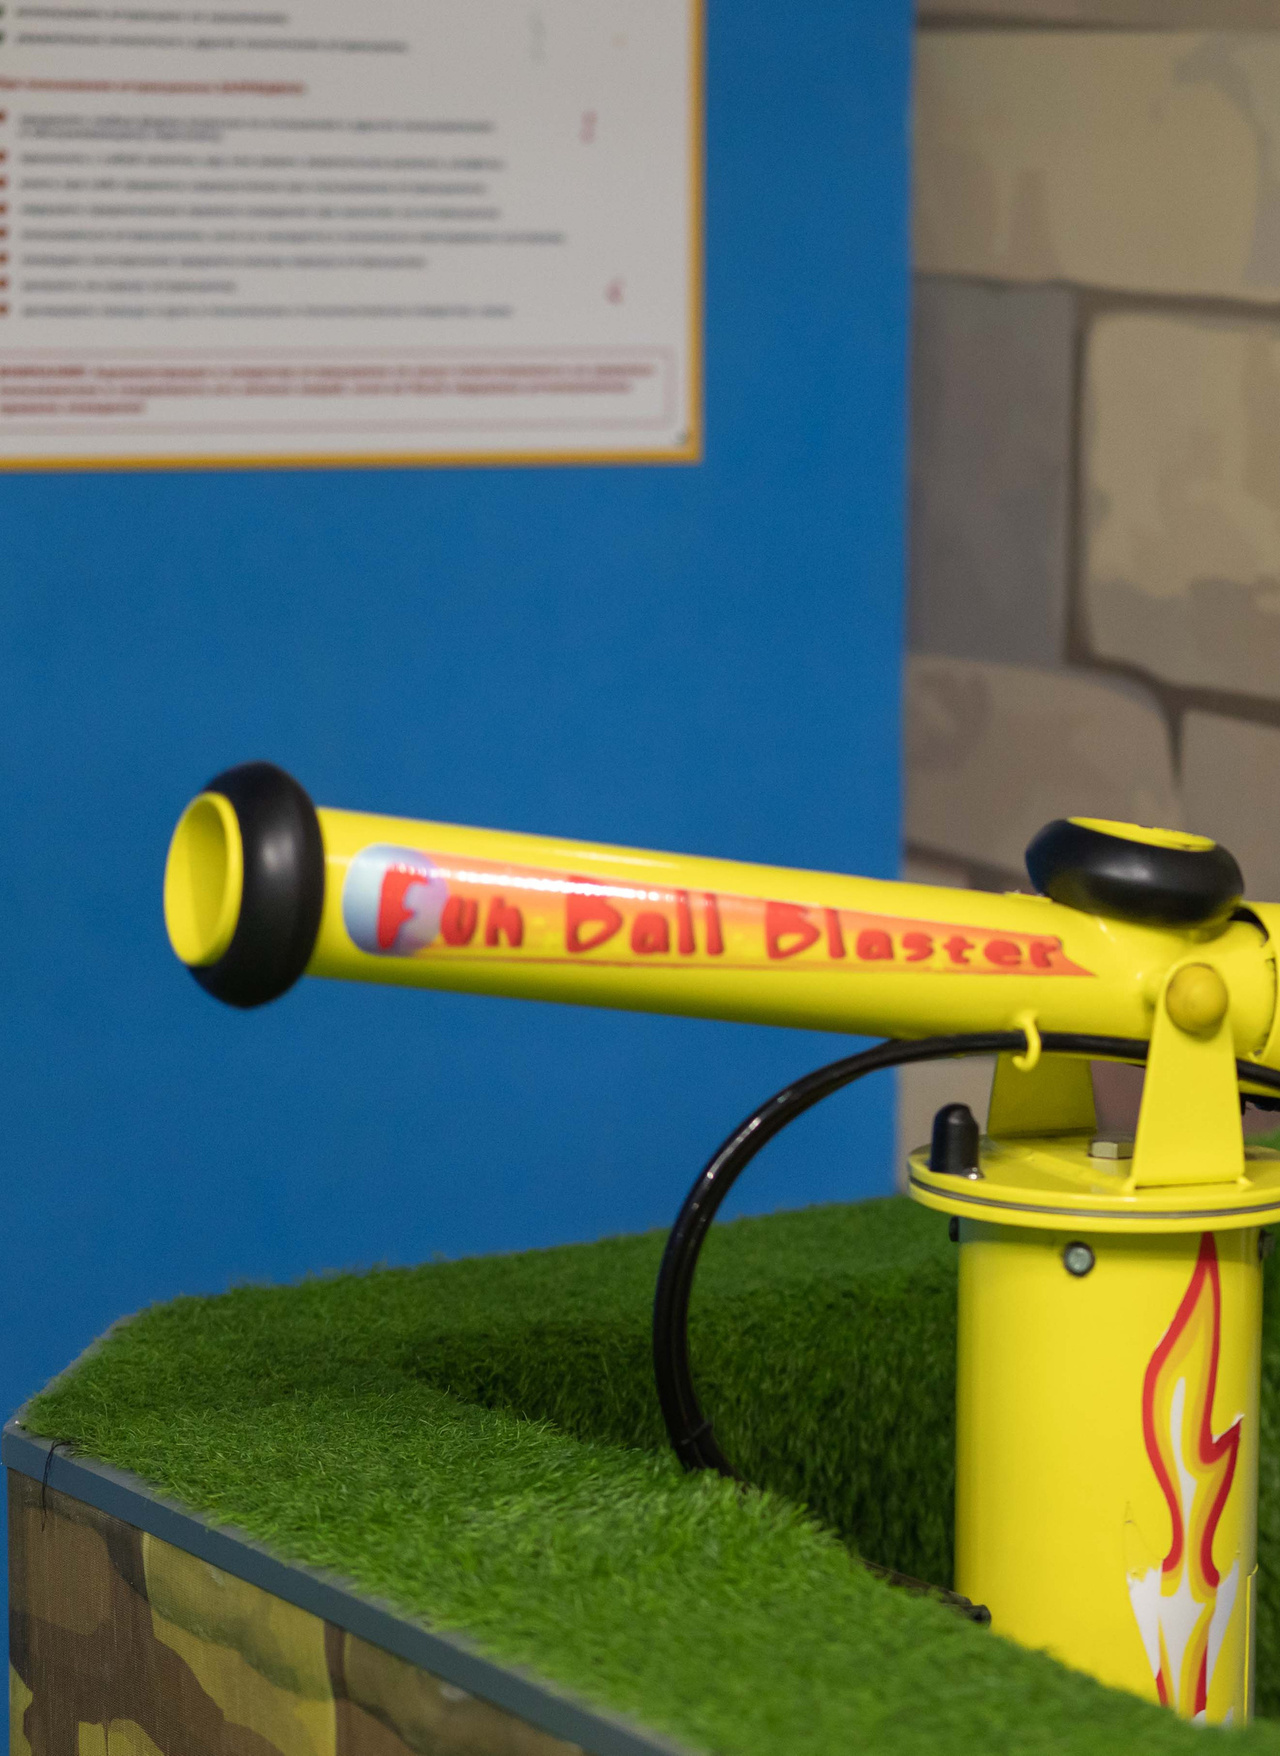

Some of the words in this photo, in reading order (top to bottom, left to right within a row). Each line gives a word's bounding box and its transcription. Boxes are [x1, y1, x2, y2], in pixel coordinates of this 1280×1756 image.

[376, 862, 525, 950] Fun
[566, 874, 724, 957] Ball
[764, 900, 1062, 969] Blaster
